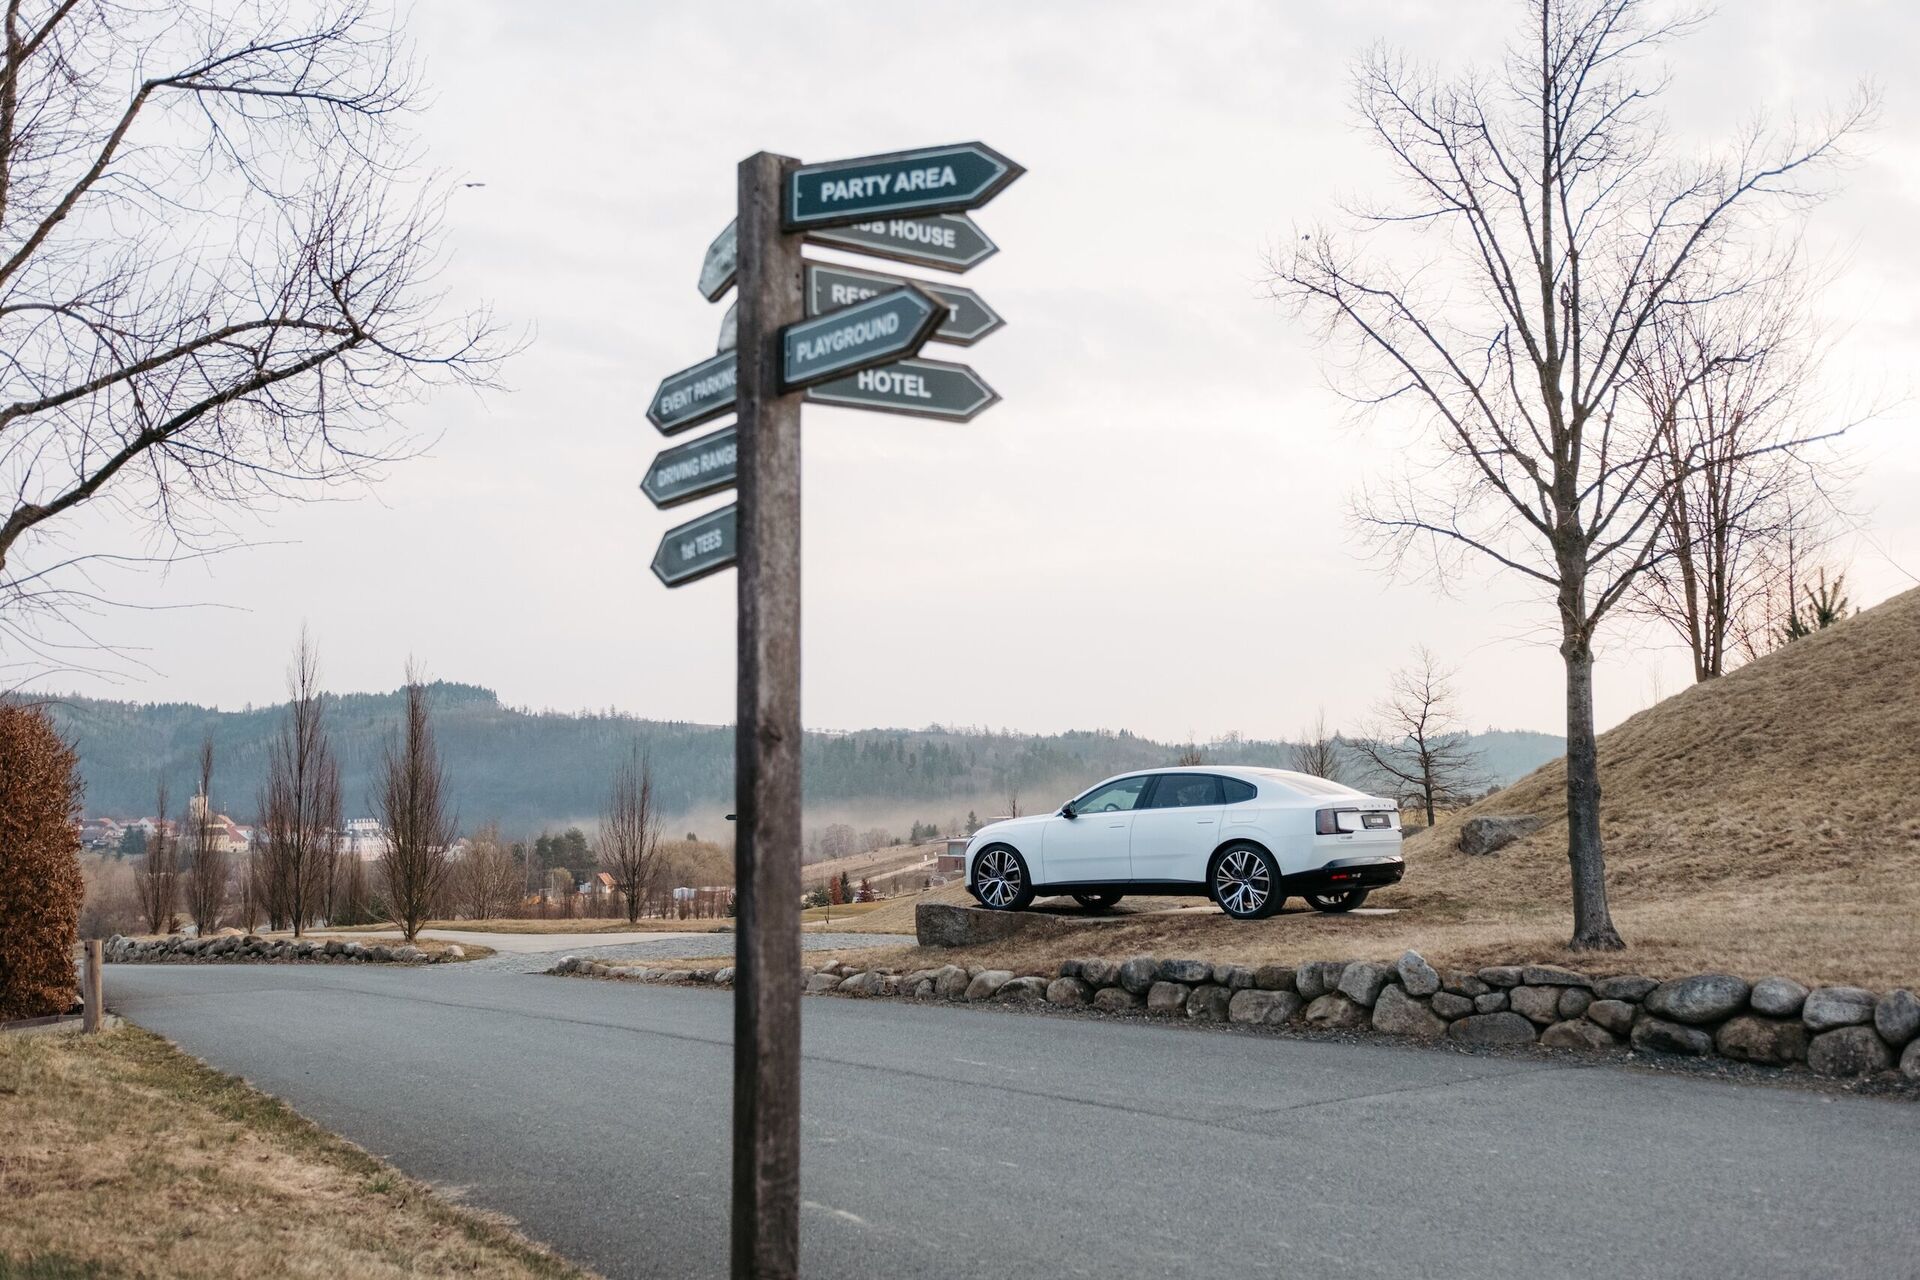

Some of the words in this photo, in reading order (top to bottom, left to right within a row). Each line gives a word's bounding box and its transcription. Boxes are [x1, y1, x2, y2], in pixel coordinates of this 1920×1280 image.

[820, 173, 892, 202] PARTY
[893, 165, 957, 193] AREA
[889, 219, 956, 249] HOUSE
[796, 311, 900, 363] PLAYGROUND
[857, 369, 932, 398] HOTEL
[660, 384, 694, 416] EVENT
[657, 456, 700, 488] DRIVING
[695, 528, 722, 555] TEES
